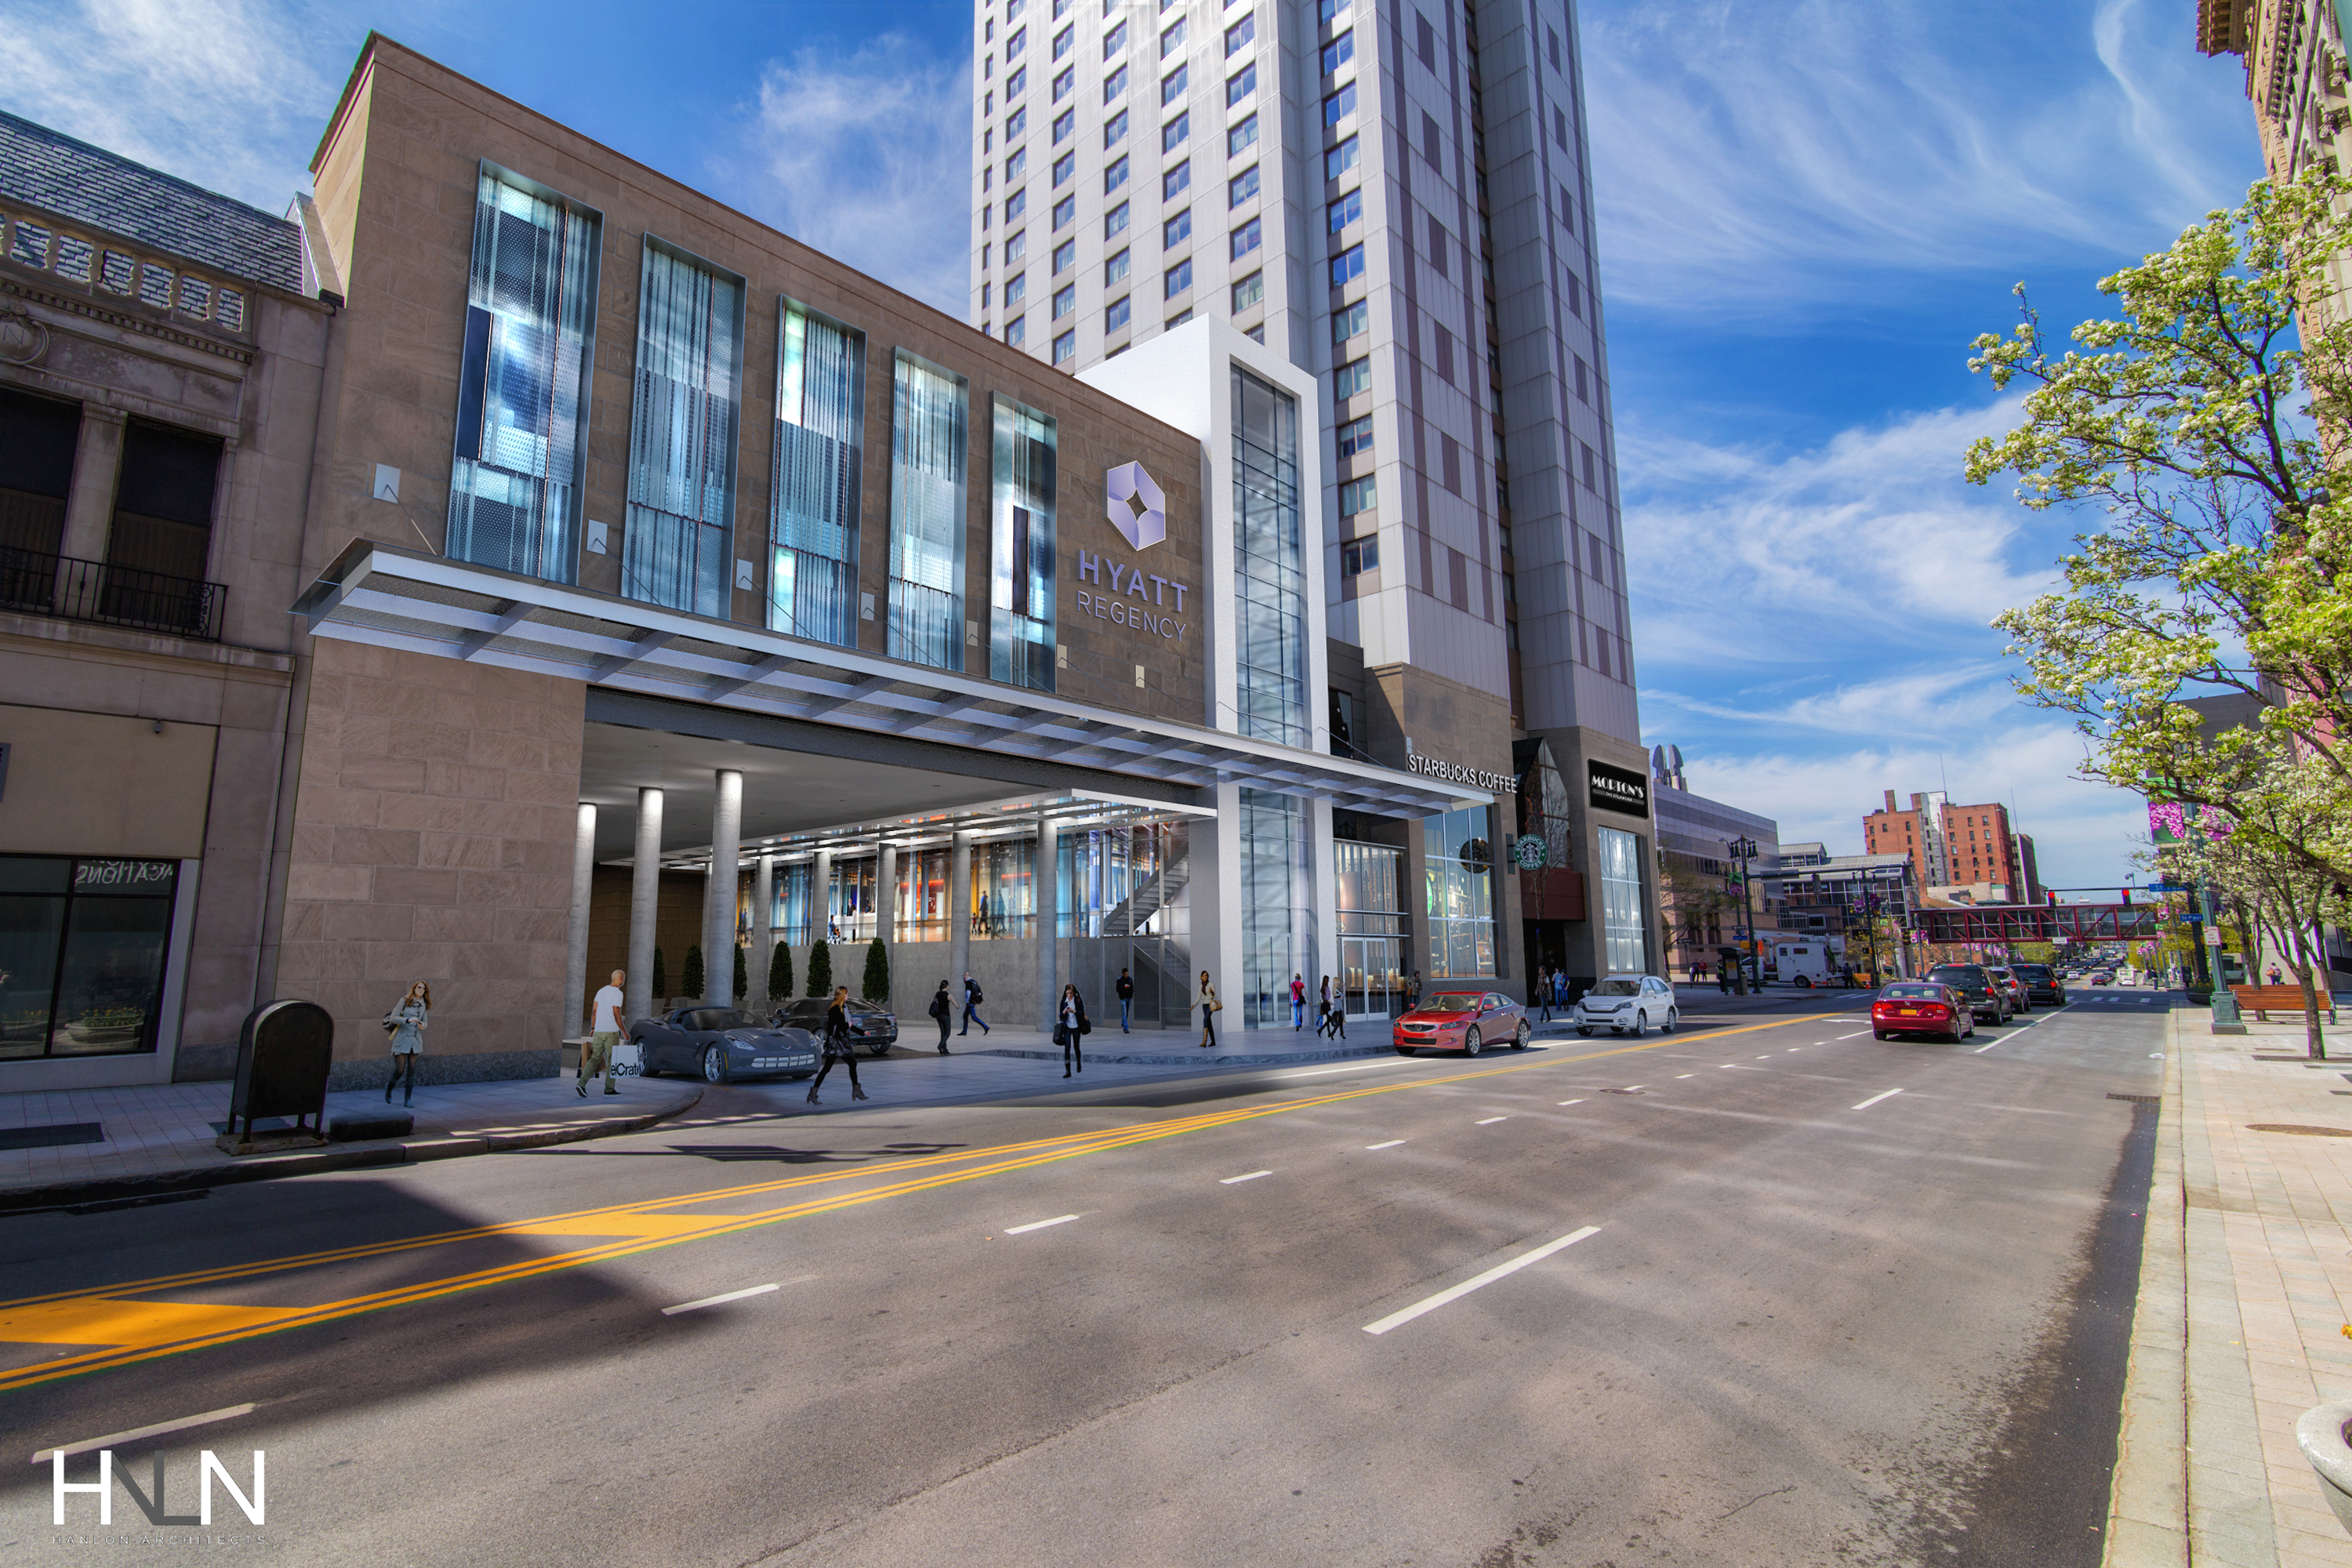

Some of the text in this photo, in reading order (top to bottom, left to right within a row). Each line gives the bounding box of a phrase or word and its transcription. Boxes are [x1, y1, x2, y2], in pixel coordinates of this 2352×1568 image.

[1077, 550, 1188, 612] HYATT
[1077, 590, 1187, 642] REGENCY
[1408, 753, 1517, 793] STARBUCKS COFFEE
[1592, 774, 1644, 799] MORTON'S
[1515, 836, 1545, 852] STARBUCKS
[1519, 859, 1542, 869] COFFEE
